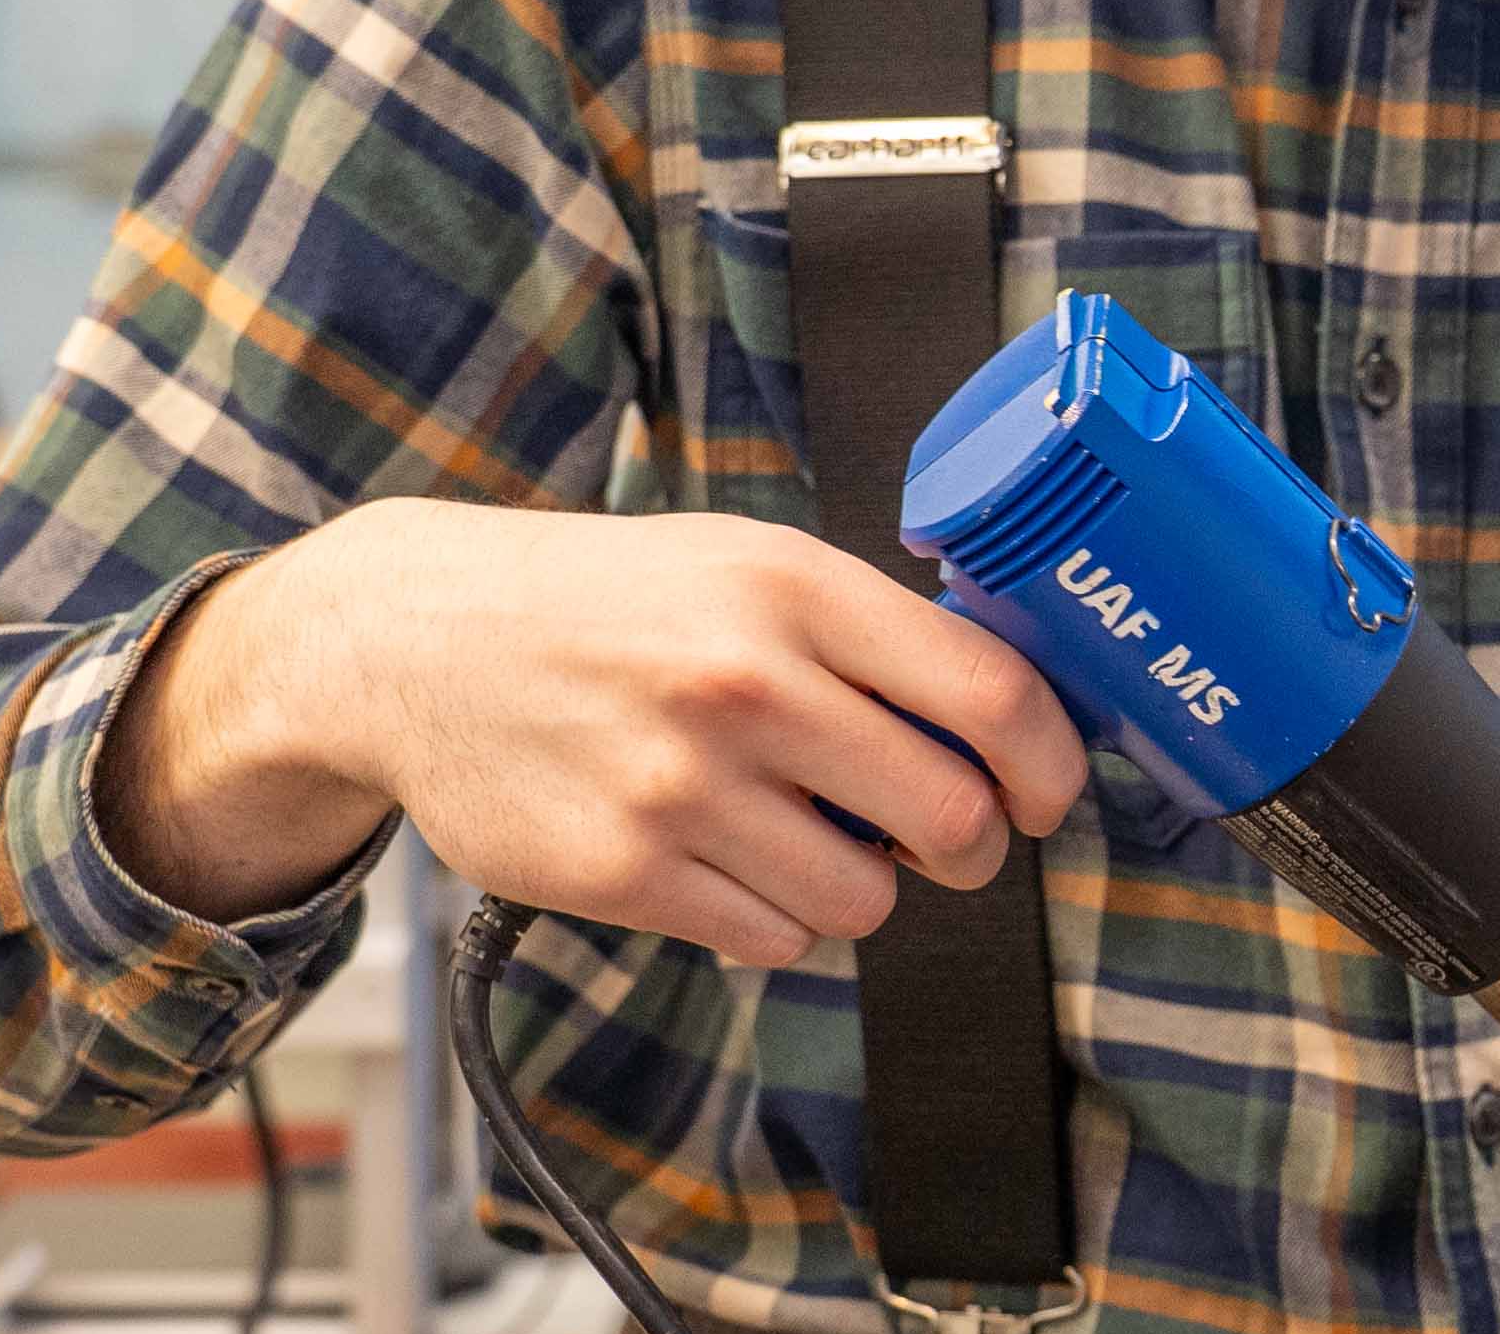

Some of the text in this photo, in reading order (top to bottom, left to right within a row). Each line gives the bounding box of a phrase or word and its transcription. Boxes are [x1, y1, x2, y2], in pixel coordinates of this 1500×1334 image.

[806, 135, 968, 161] carhartt
[1055, 547, 1241, 726] UAF MS
[1270, 799, 1324, 844] WARNING:
